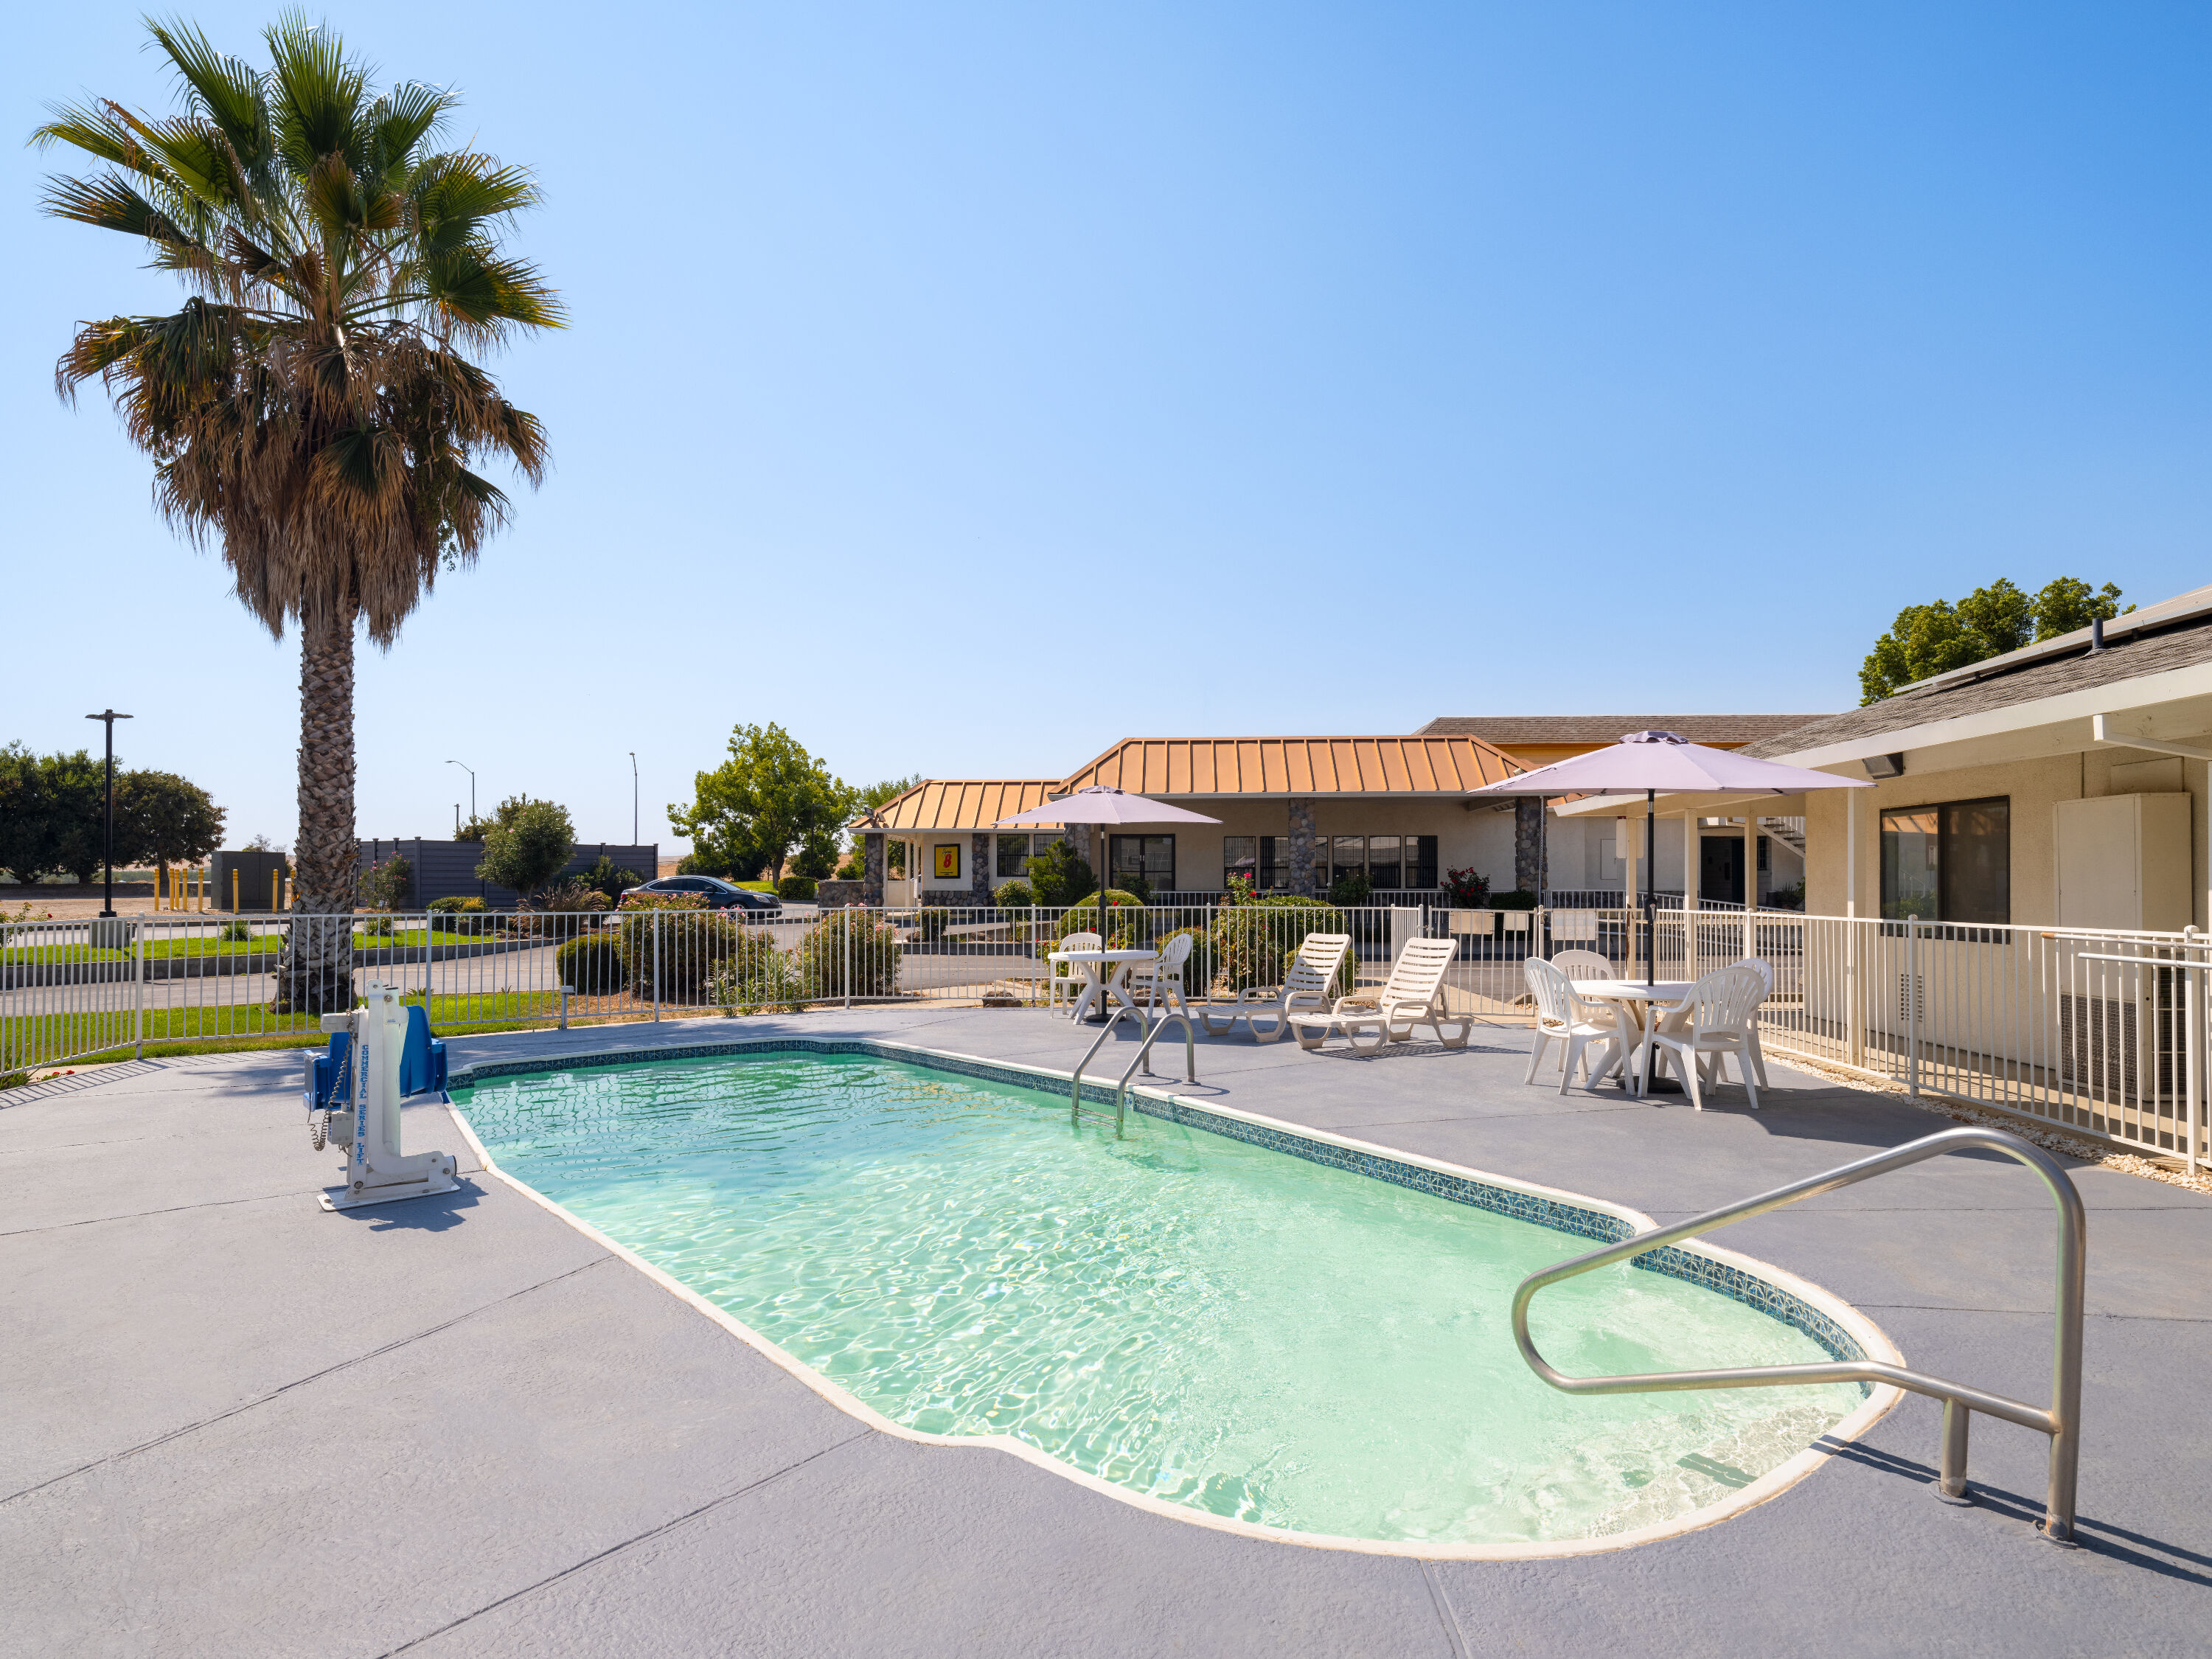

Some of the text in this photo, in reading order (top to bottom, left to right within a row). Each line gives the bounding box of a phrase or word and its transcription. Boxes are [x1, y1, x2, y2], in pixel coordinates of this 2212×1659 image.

[943, 854, 952, 868] 8
[356, 1044, 369, 1166] COMMERCIAL SERIES LIFT
